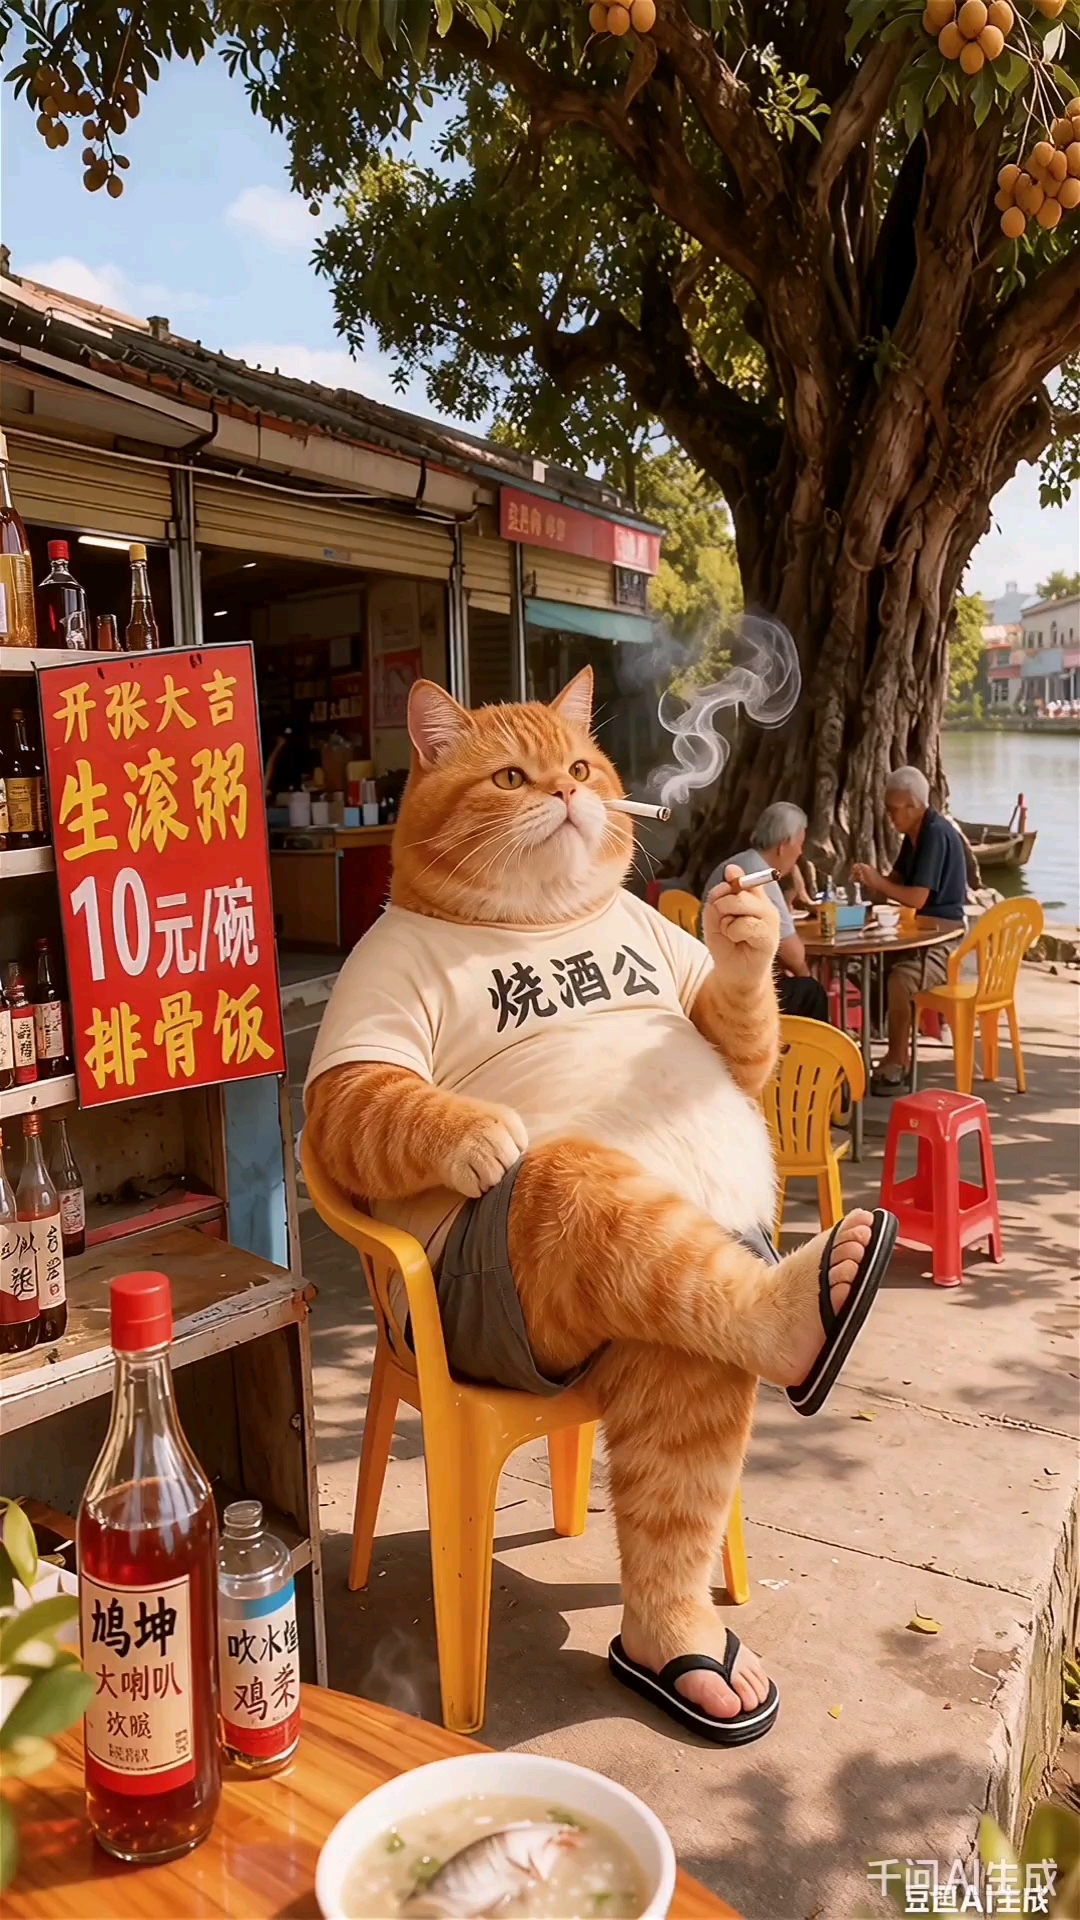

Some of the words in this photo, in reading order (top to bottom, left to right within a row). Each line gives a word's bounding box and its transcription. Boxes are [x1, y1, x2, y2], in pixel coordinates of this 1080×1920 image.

[53, 668, 238, 744] 开张大吉
[59, 742, 248, 861] 生滚粥
[70, 866, 259, 982] 10元/碗
[84, 983, 275, 1089] 排骨饭
[487, 944, 660, 1033] 烧酒公
[95, 1661, 183, 1702] 大喇叭
